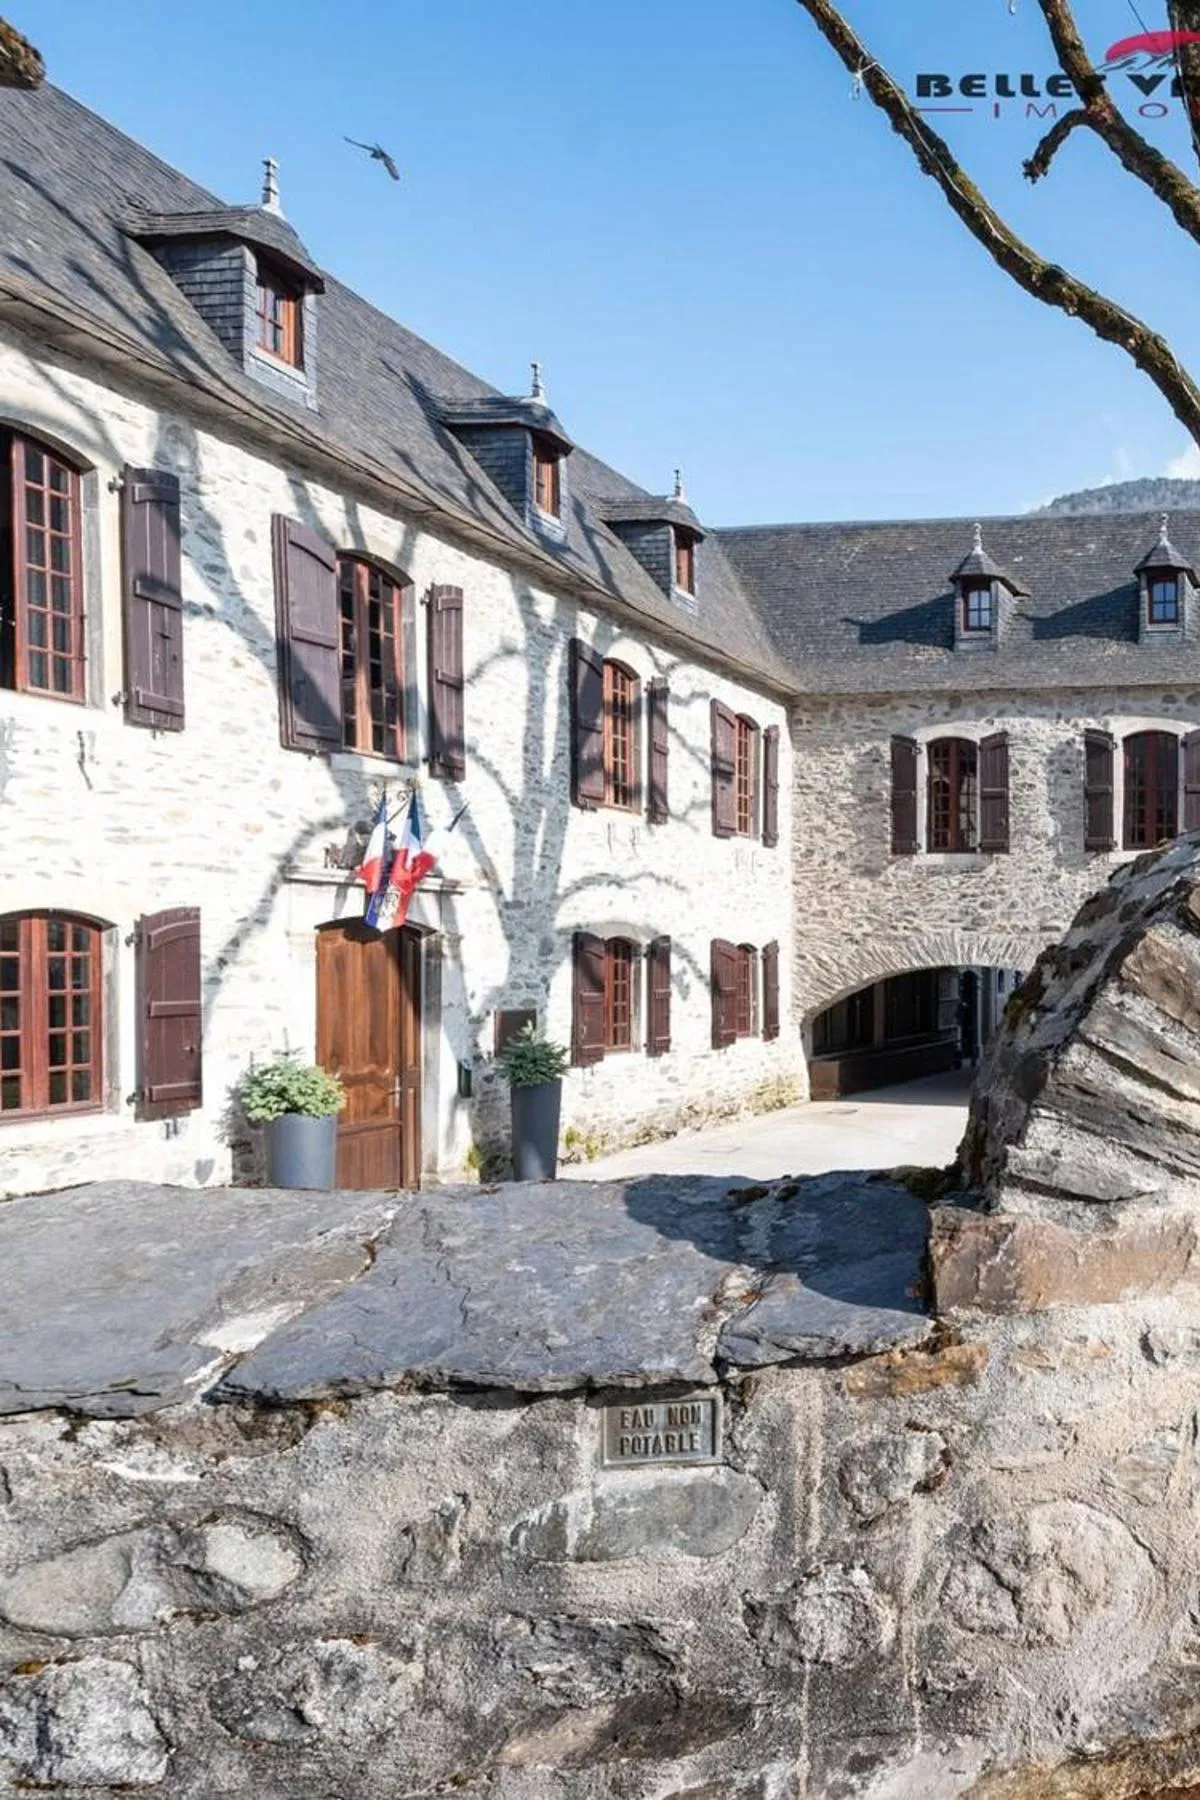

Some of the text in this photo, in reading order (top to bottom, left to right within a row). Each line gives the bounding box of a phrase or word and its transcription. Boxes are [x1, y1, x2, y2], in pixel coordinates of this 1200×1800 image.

[620, 1404, 702, 1429] EAU NON
[620, 1431, 699, 1456] POTABLE
